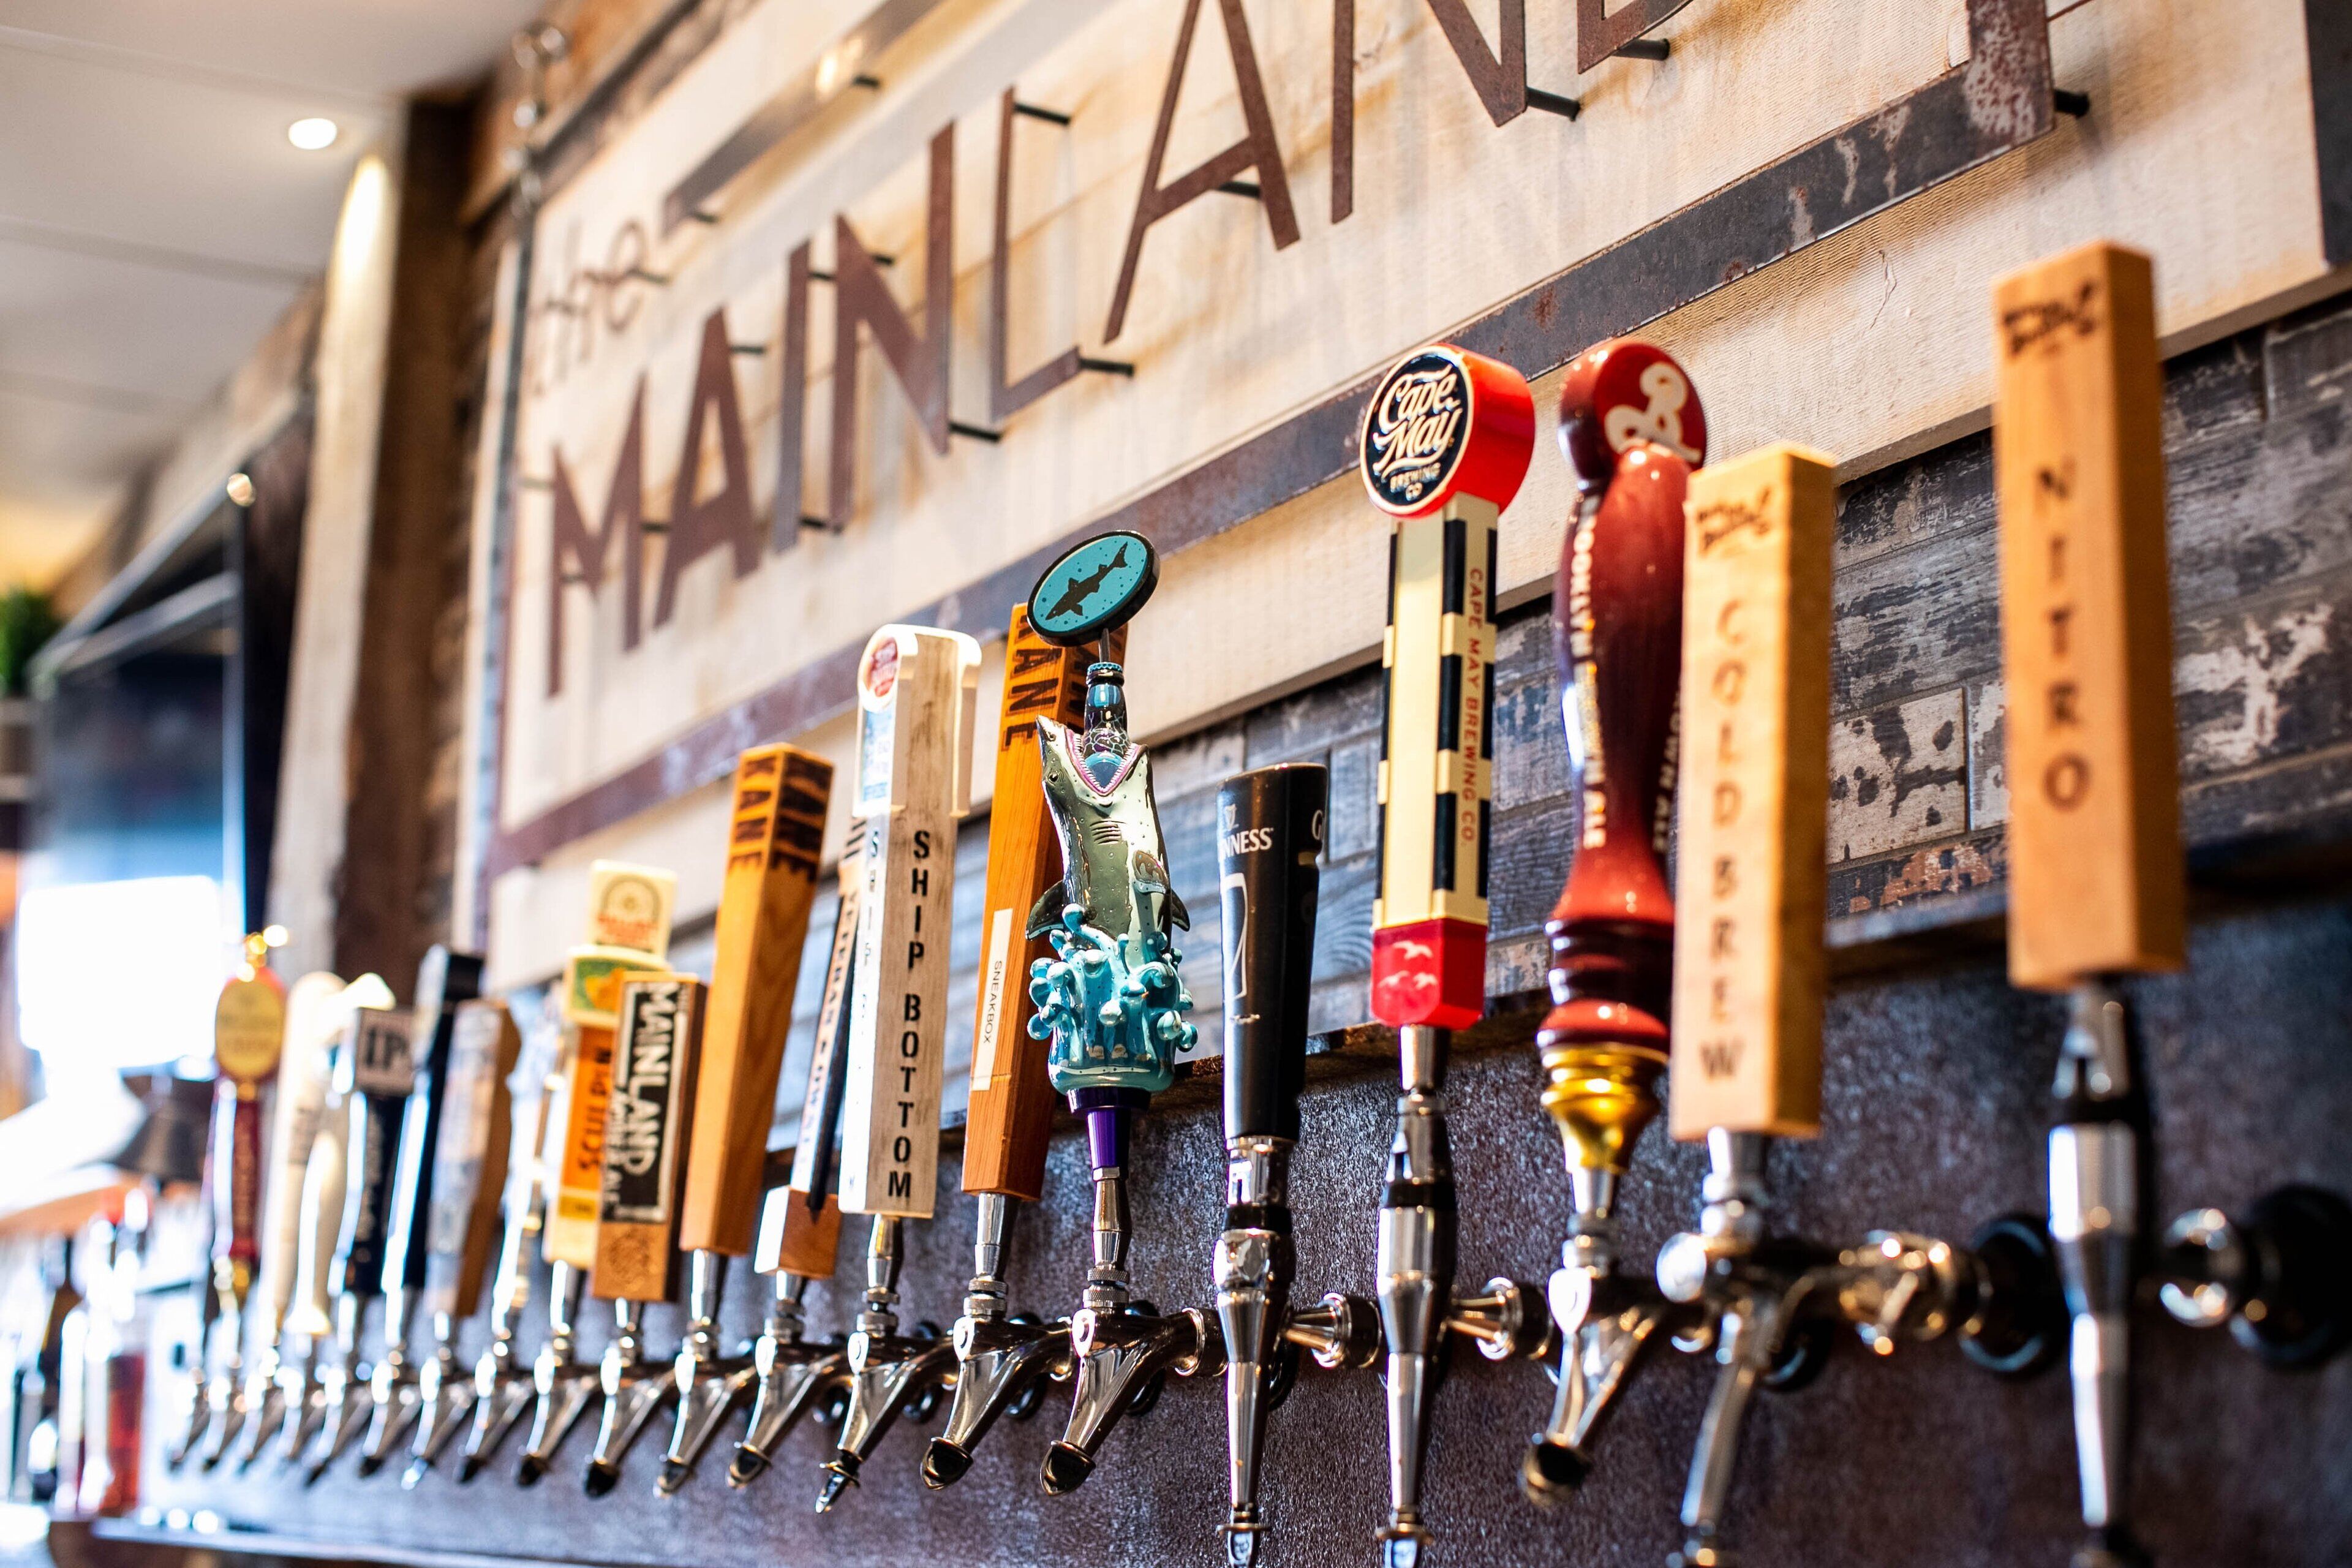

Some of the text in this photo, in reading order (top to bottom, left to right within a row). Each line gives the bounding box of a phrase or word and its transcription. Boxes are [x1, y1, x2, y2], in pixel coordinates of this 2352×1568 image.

[546, 0, 1693, 698] MAINLA
[1379, 363, 1460, 434] Cape
[1373, 409, 1463, 483] May
[1390, 462, 1441, 492] BREWING
[1469, 568, 1483, 630] CAPE
[2034, 454, 2090, 813] NITRO
[1467, 638, 1482, 688] MAY
[1711, 599, 1747, 828] COLD
[1461, 696, 1480, 802] BREWING
[888, 830, 930, 1199] SHIP BOTTOM
[984, 960, 1002, 1044] SNEAKBOX
[1699, 855, 1744, 1084] BREW
[625, 982, 680, 1177] MAINLAND
